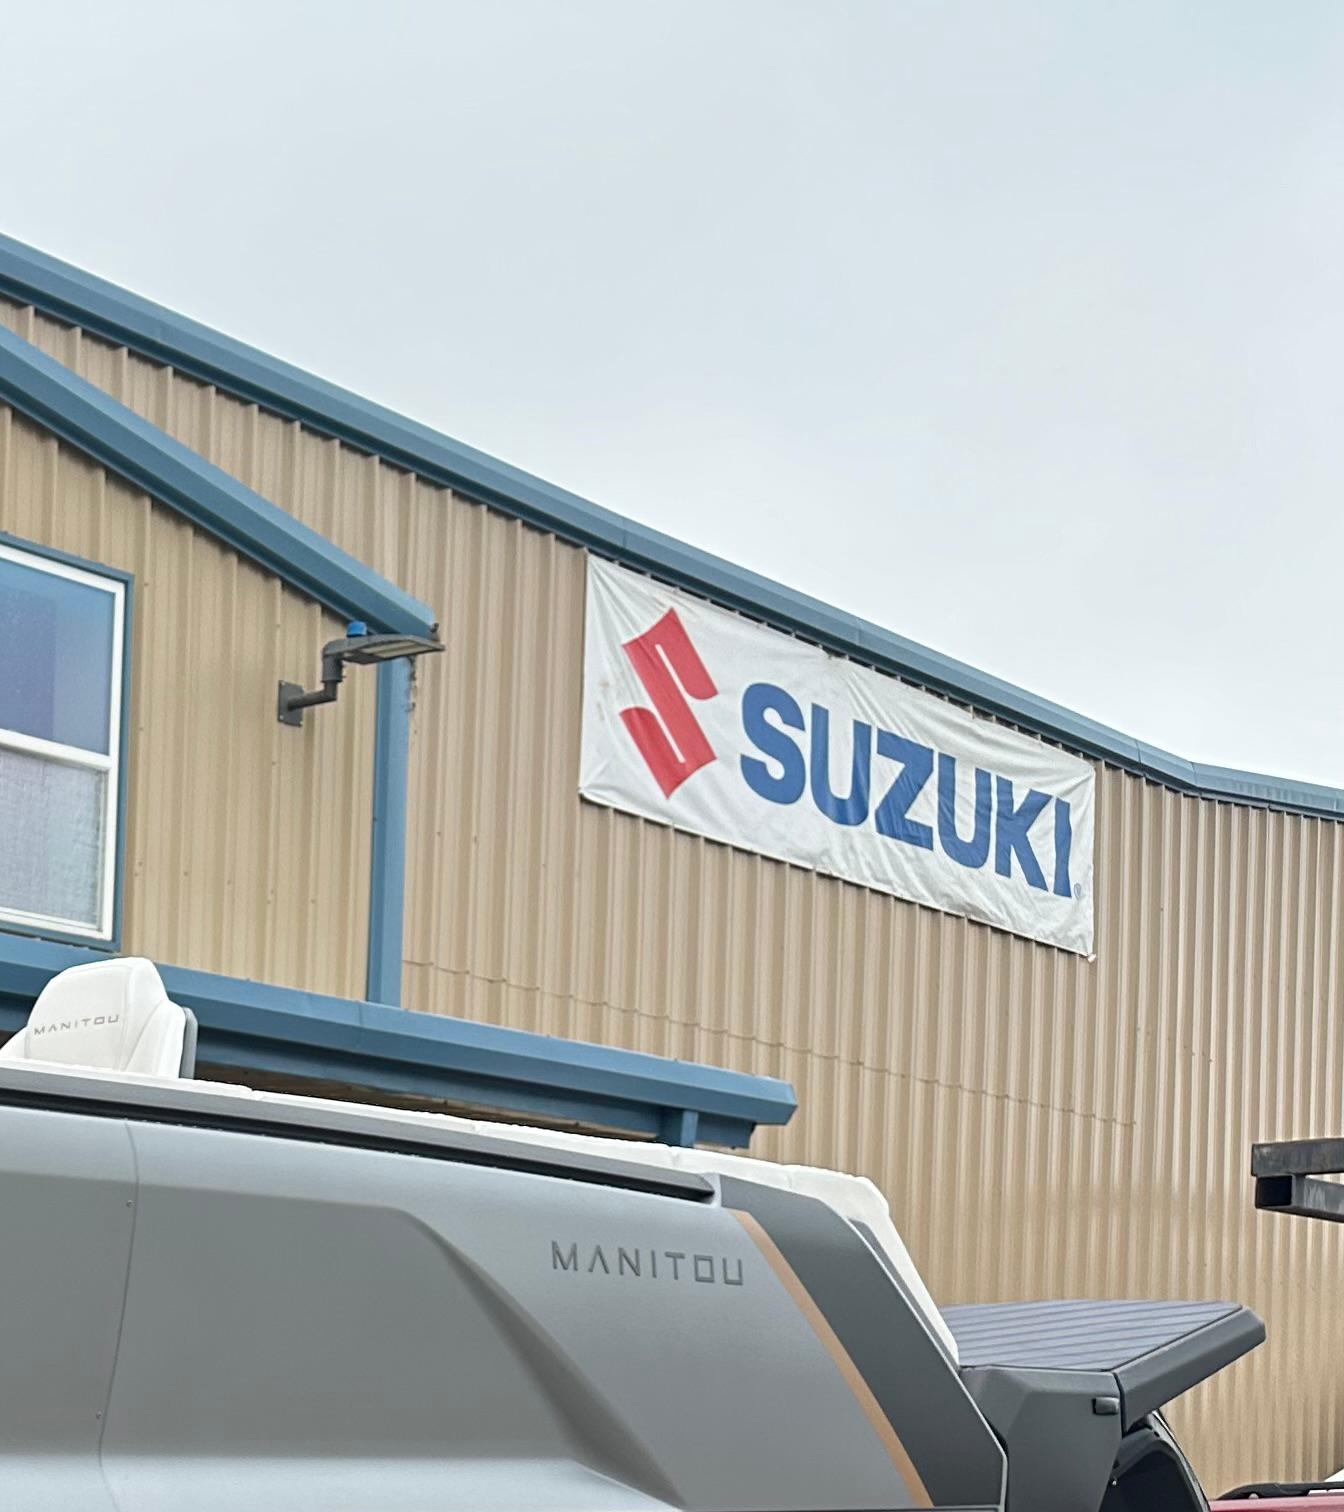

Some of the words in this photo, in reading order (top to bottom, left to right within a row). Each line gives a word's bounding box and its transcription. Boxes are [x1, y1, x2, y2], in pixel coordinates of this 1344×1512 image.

[739, 682, 1073, 898] SUZUKI
[33, 1014, 119, 1036] MANITOU
[550, 1240, 744, 1286] MANITOU
